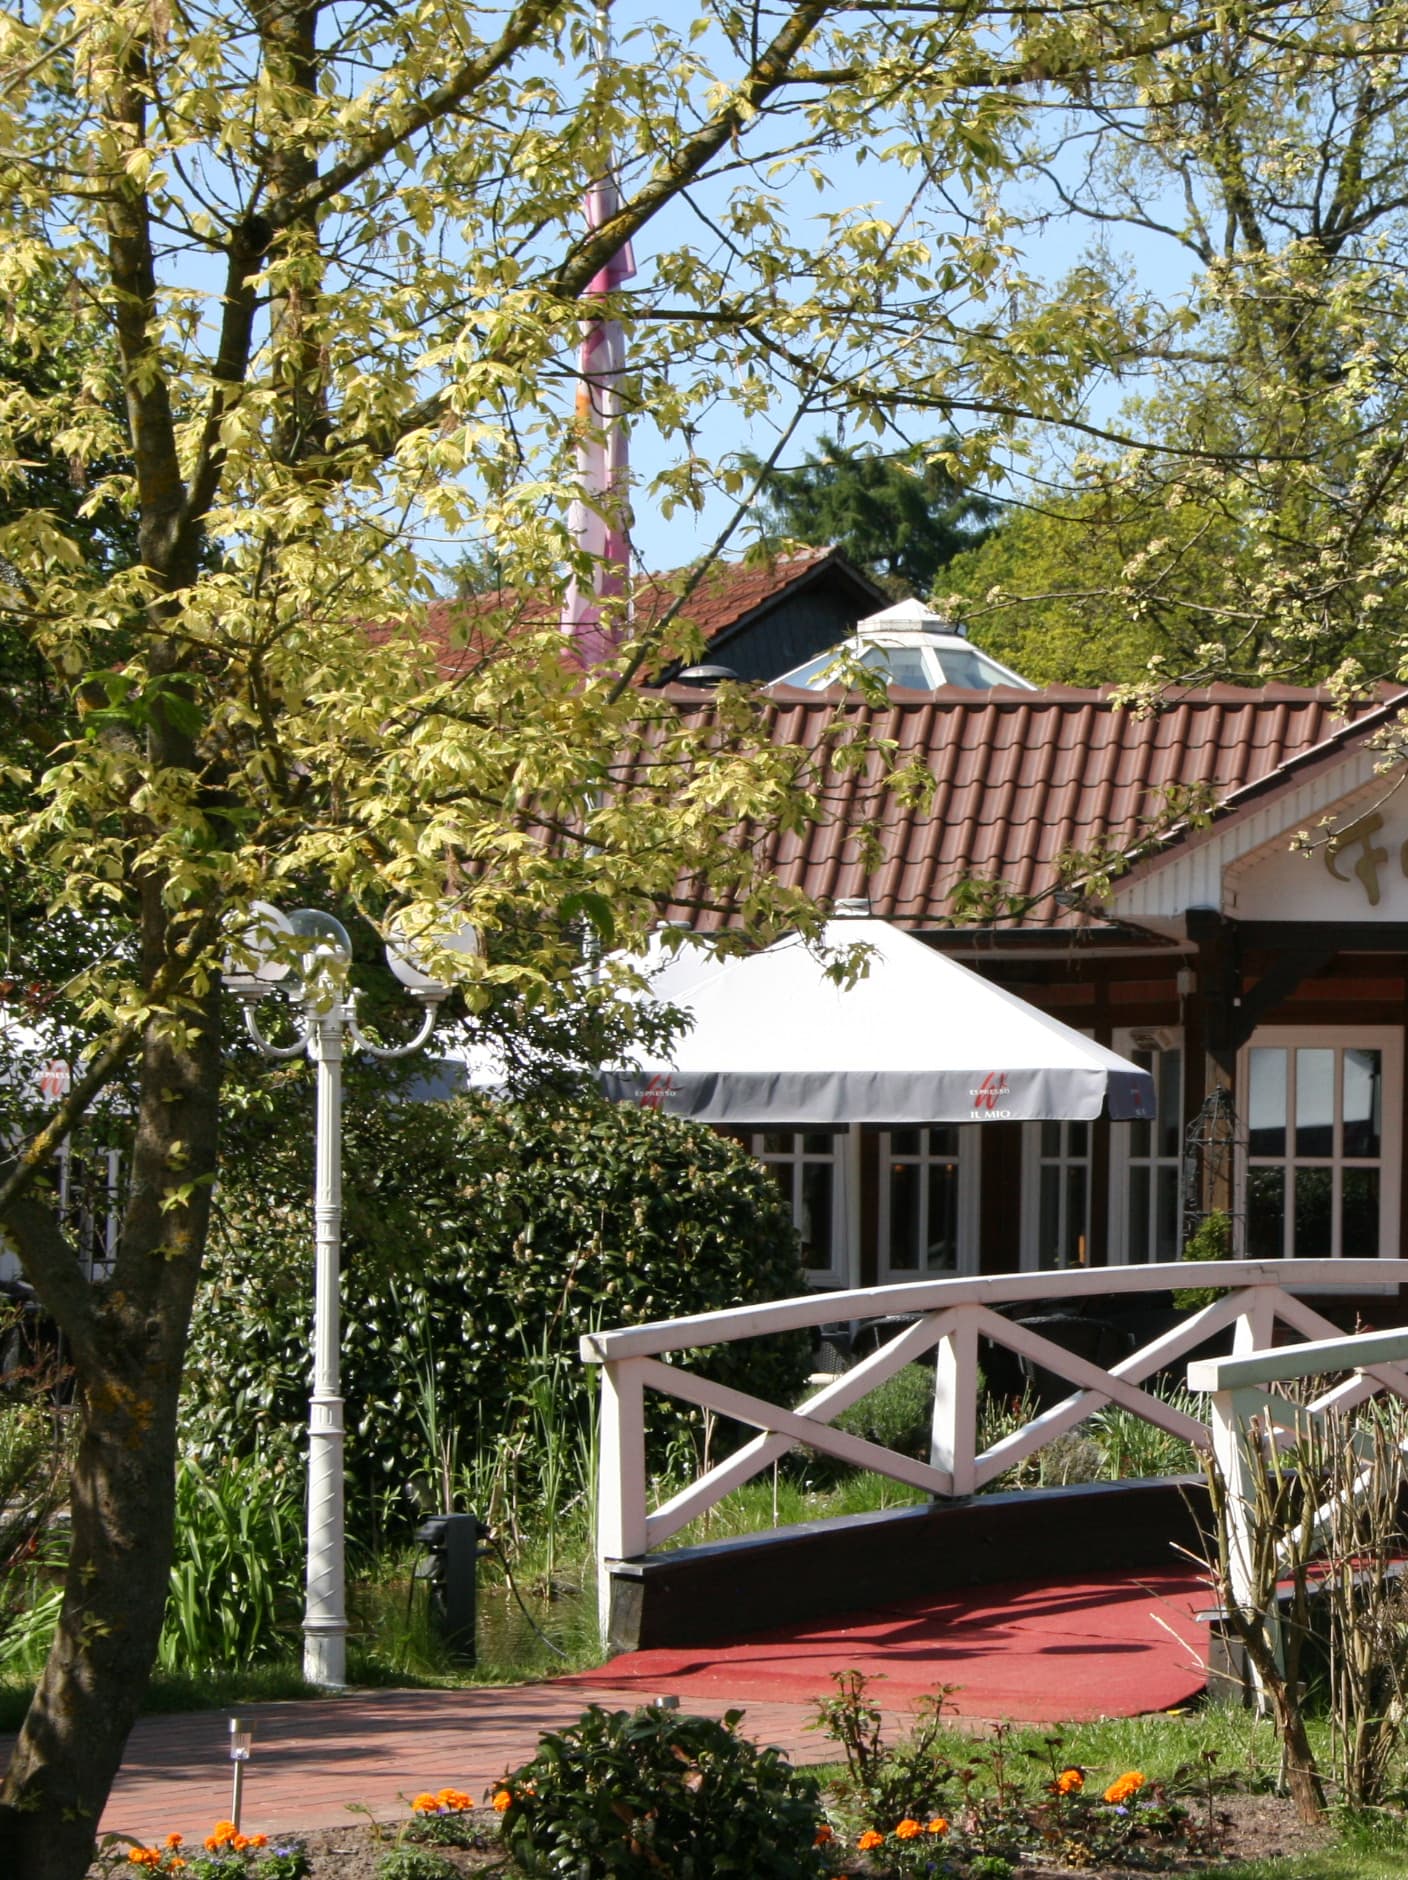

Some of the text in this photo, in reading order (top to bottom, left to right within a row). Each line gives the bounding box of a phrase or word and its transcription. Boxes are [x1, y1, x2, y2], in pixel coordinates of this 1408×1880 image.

[34, 1071, 71, 1079] ESPRESS
[970, 1110, 1011, 1119] IL MIO
